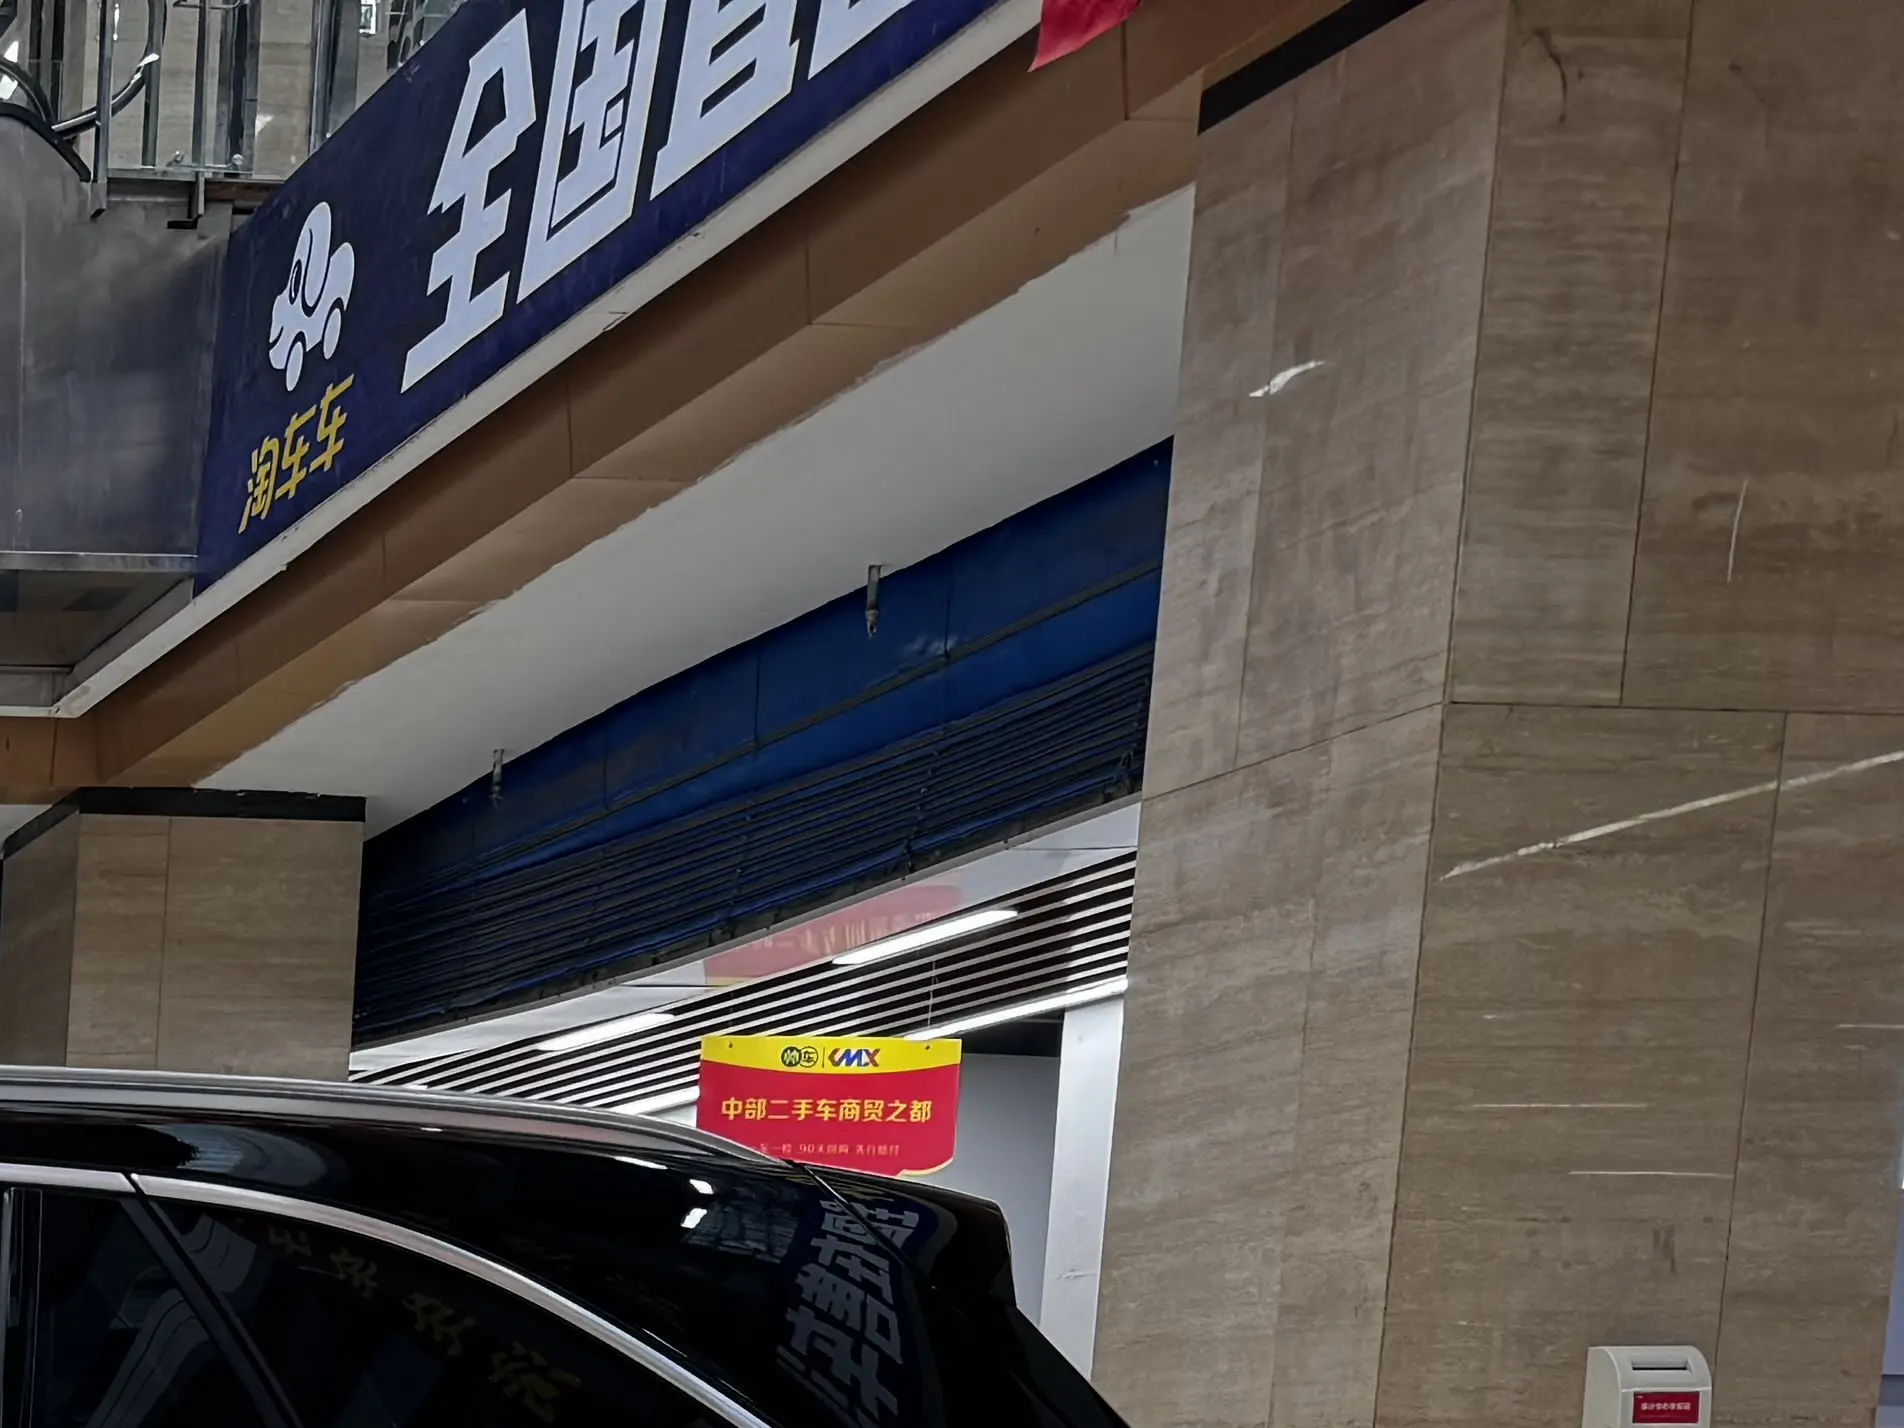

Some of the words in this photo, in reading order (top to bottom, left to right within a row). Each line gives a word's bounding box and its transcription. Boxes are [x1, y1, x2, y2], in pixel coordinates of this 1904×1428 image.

[238, 373, 355, 535] 淘车车
[720, 1097, 933, 1124] 中部二手车商贸之都
